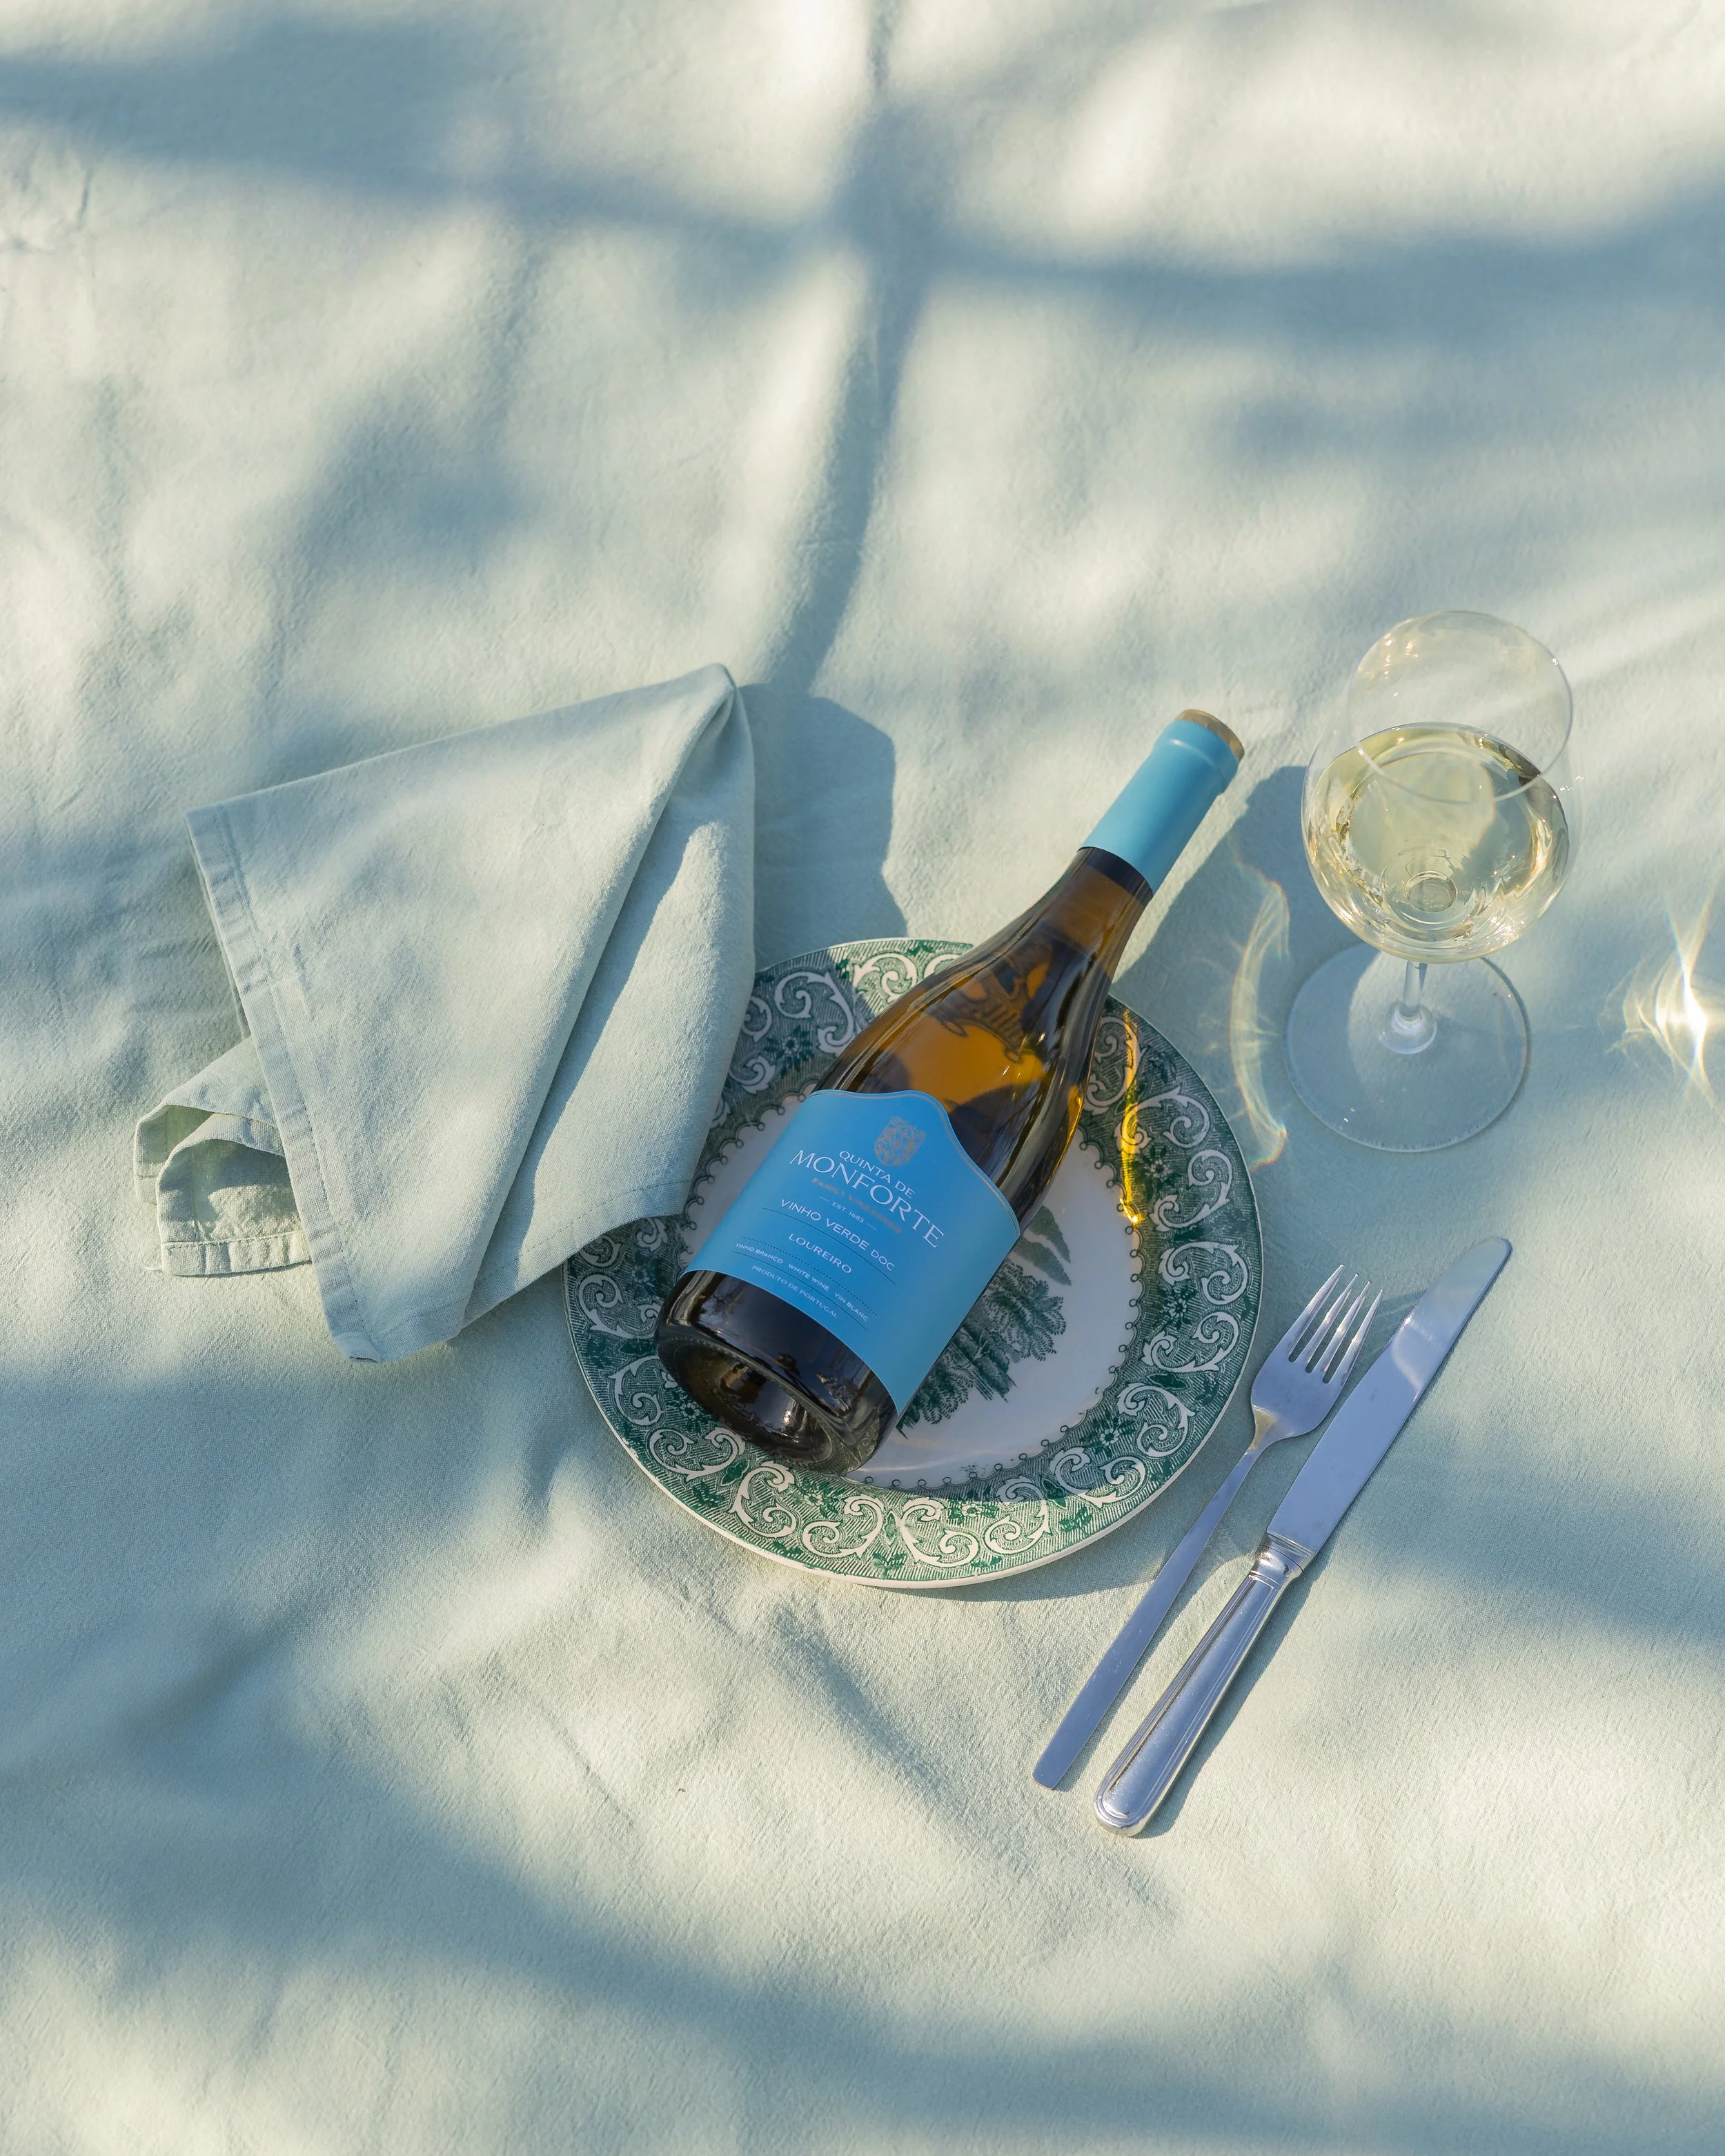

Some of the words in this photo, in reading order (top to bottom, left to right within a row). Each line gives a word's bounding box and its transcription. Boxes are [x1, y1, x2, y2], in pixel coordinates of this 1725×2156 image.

[839, 1151, 891, 1183] QUINTA
[894, 1180, 915, 1198] DE
[789, 1150, 944, 1247] MONFORTE
[849, 1211, 865, 1223] 1683
[782, 1199, 821, 1221] VINHO
[826, 1218, 869, 1251] VERDE
[870, 1249, 894, 1271] DOC
[789, 1234, 851, 1274] LOUREIRO
[736, 1243, 755, 1252] VINHO
[756, 1249, 784, 1264] BRANCO
[788, 1263, 811, 1278] WHITE
[811, 1276, 830, 1292] WINE
[834, 1292, 846, 1303] VIN
[846, 1301, 869, 1322] BLANC
[788, 1283, 799, 1292] DE
[799, 1289, 838, 1319] PORTUGAL
